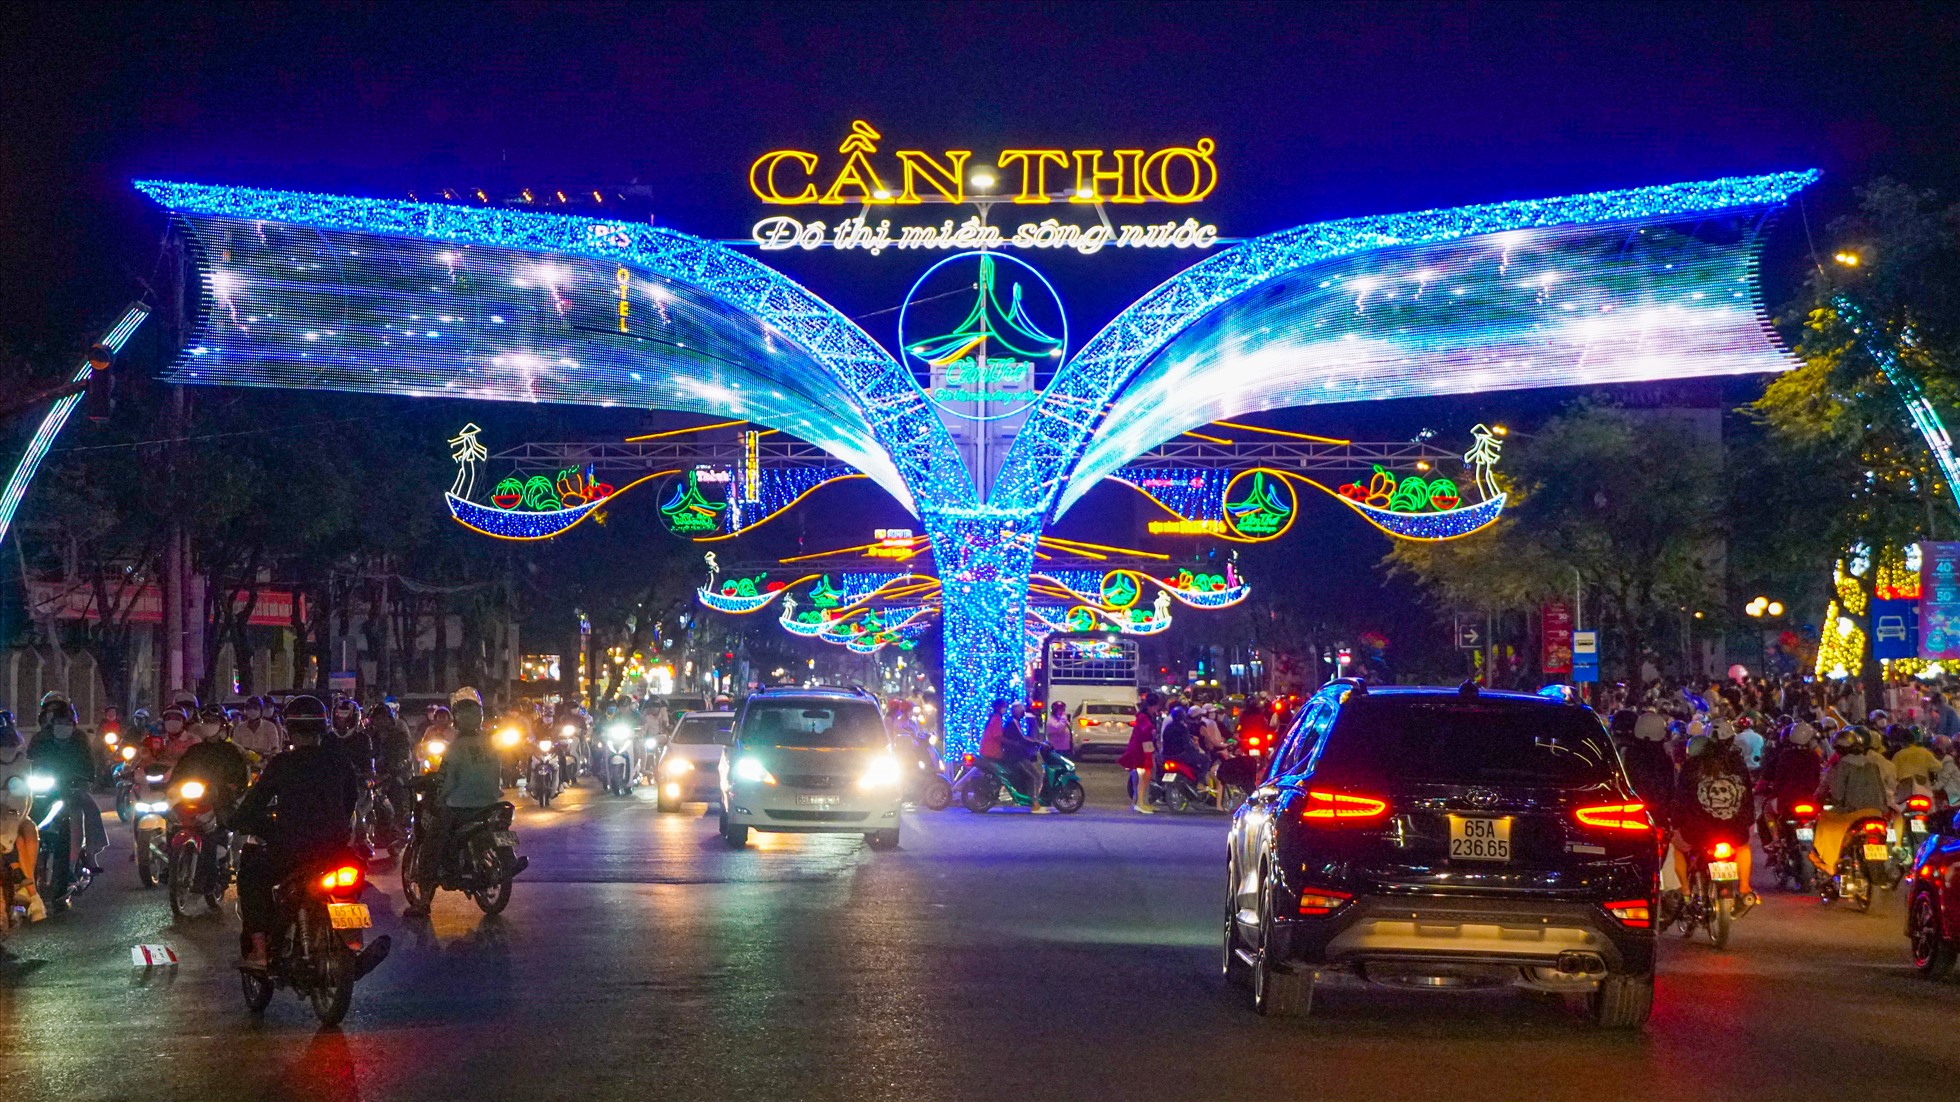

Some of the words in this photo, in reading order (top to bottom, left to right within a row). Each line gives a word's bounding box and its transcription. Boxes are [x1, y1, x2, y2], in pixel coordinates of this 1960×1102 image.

[749, 119, 972, 205] CẦN
[997, 137, 1218, 204] THƠ
[752, 216, 826, 250] Đô
[833, 217, 891, 256] thị
[898, 214, 1003, 250] miền
[1012, 218, 1112, 254] sông
[1117, 217, 1218, 249] nước
[615, 258, 631, 333] OTEL
[1452, 839, 1508, 857] 236.65
[1464, 820, 1495, 838] 65A
